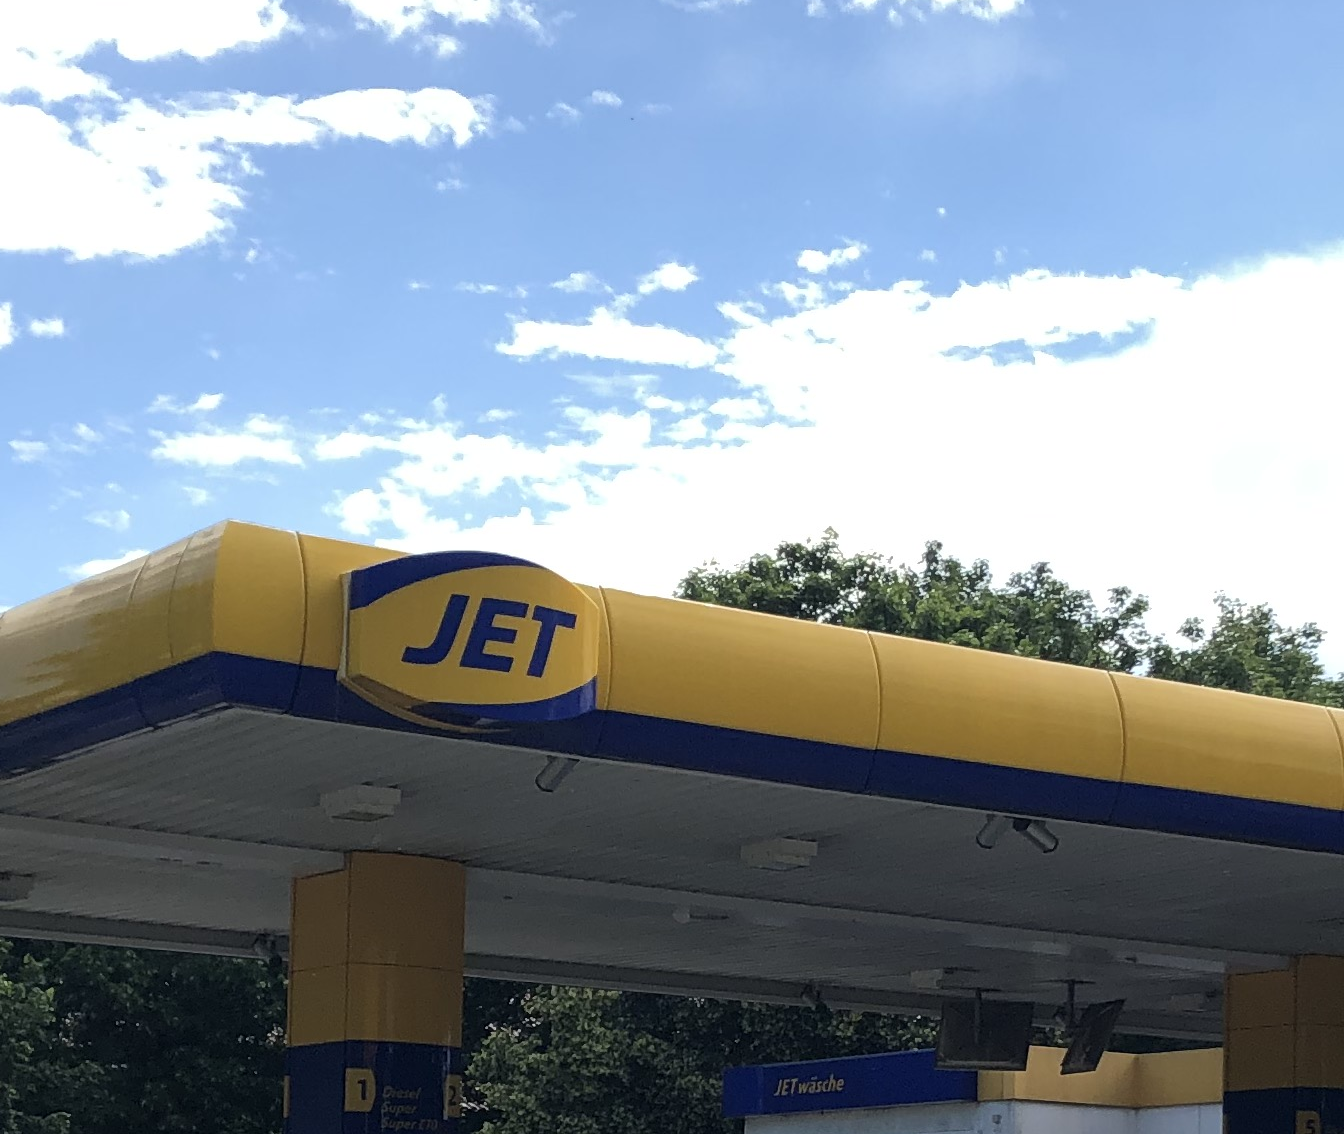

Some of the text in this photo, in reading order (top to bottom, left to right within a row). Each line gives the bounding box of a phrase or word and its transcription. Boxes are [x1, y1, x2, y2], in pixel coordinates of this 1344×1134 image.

[401, 593, 578, 677] JET
[357, 1078, 367, 1101] 1
[382, 1085, 422, 1100] Diesel
[448, 1085, 458, 1106] 2
[381, 1101, 417, 1117] Super
[381, 1116, 417, 1132] Super
